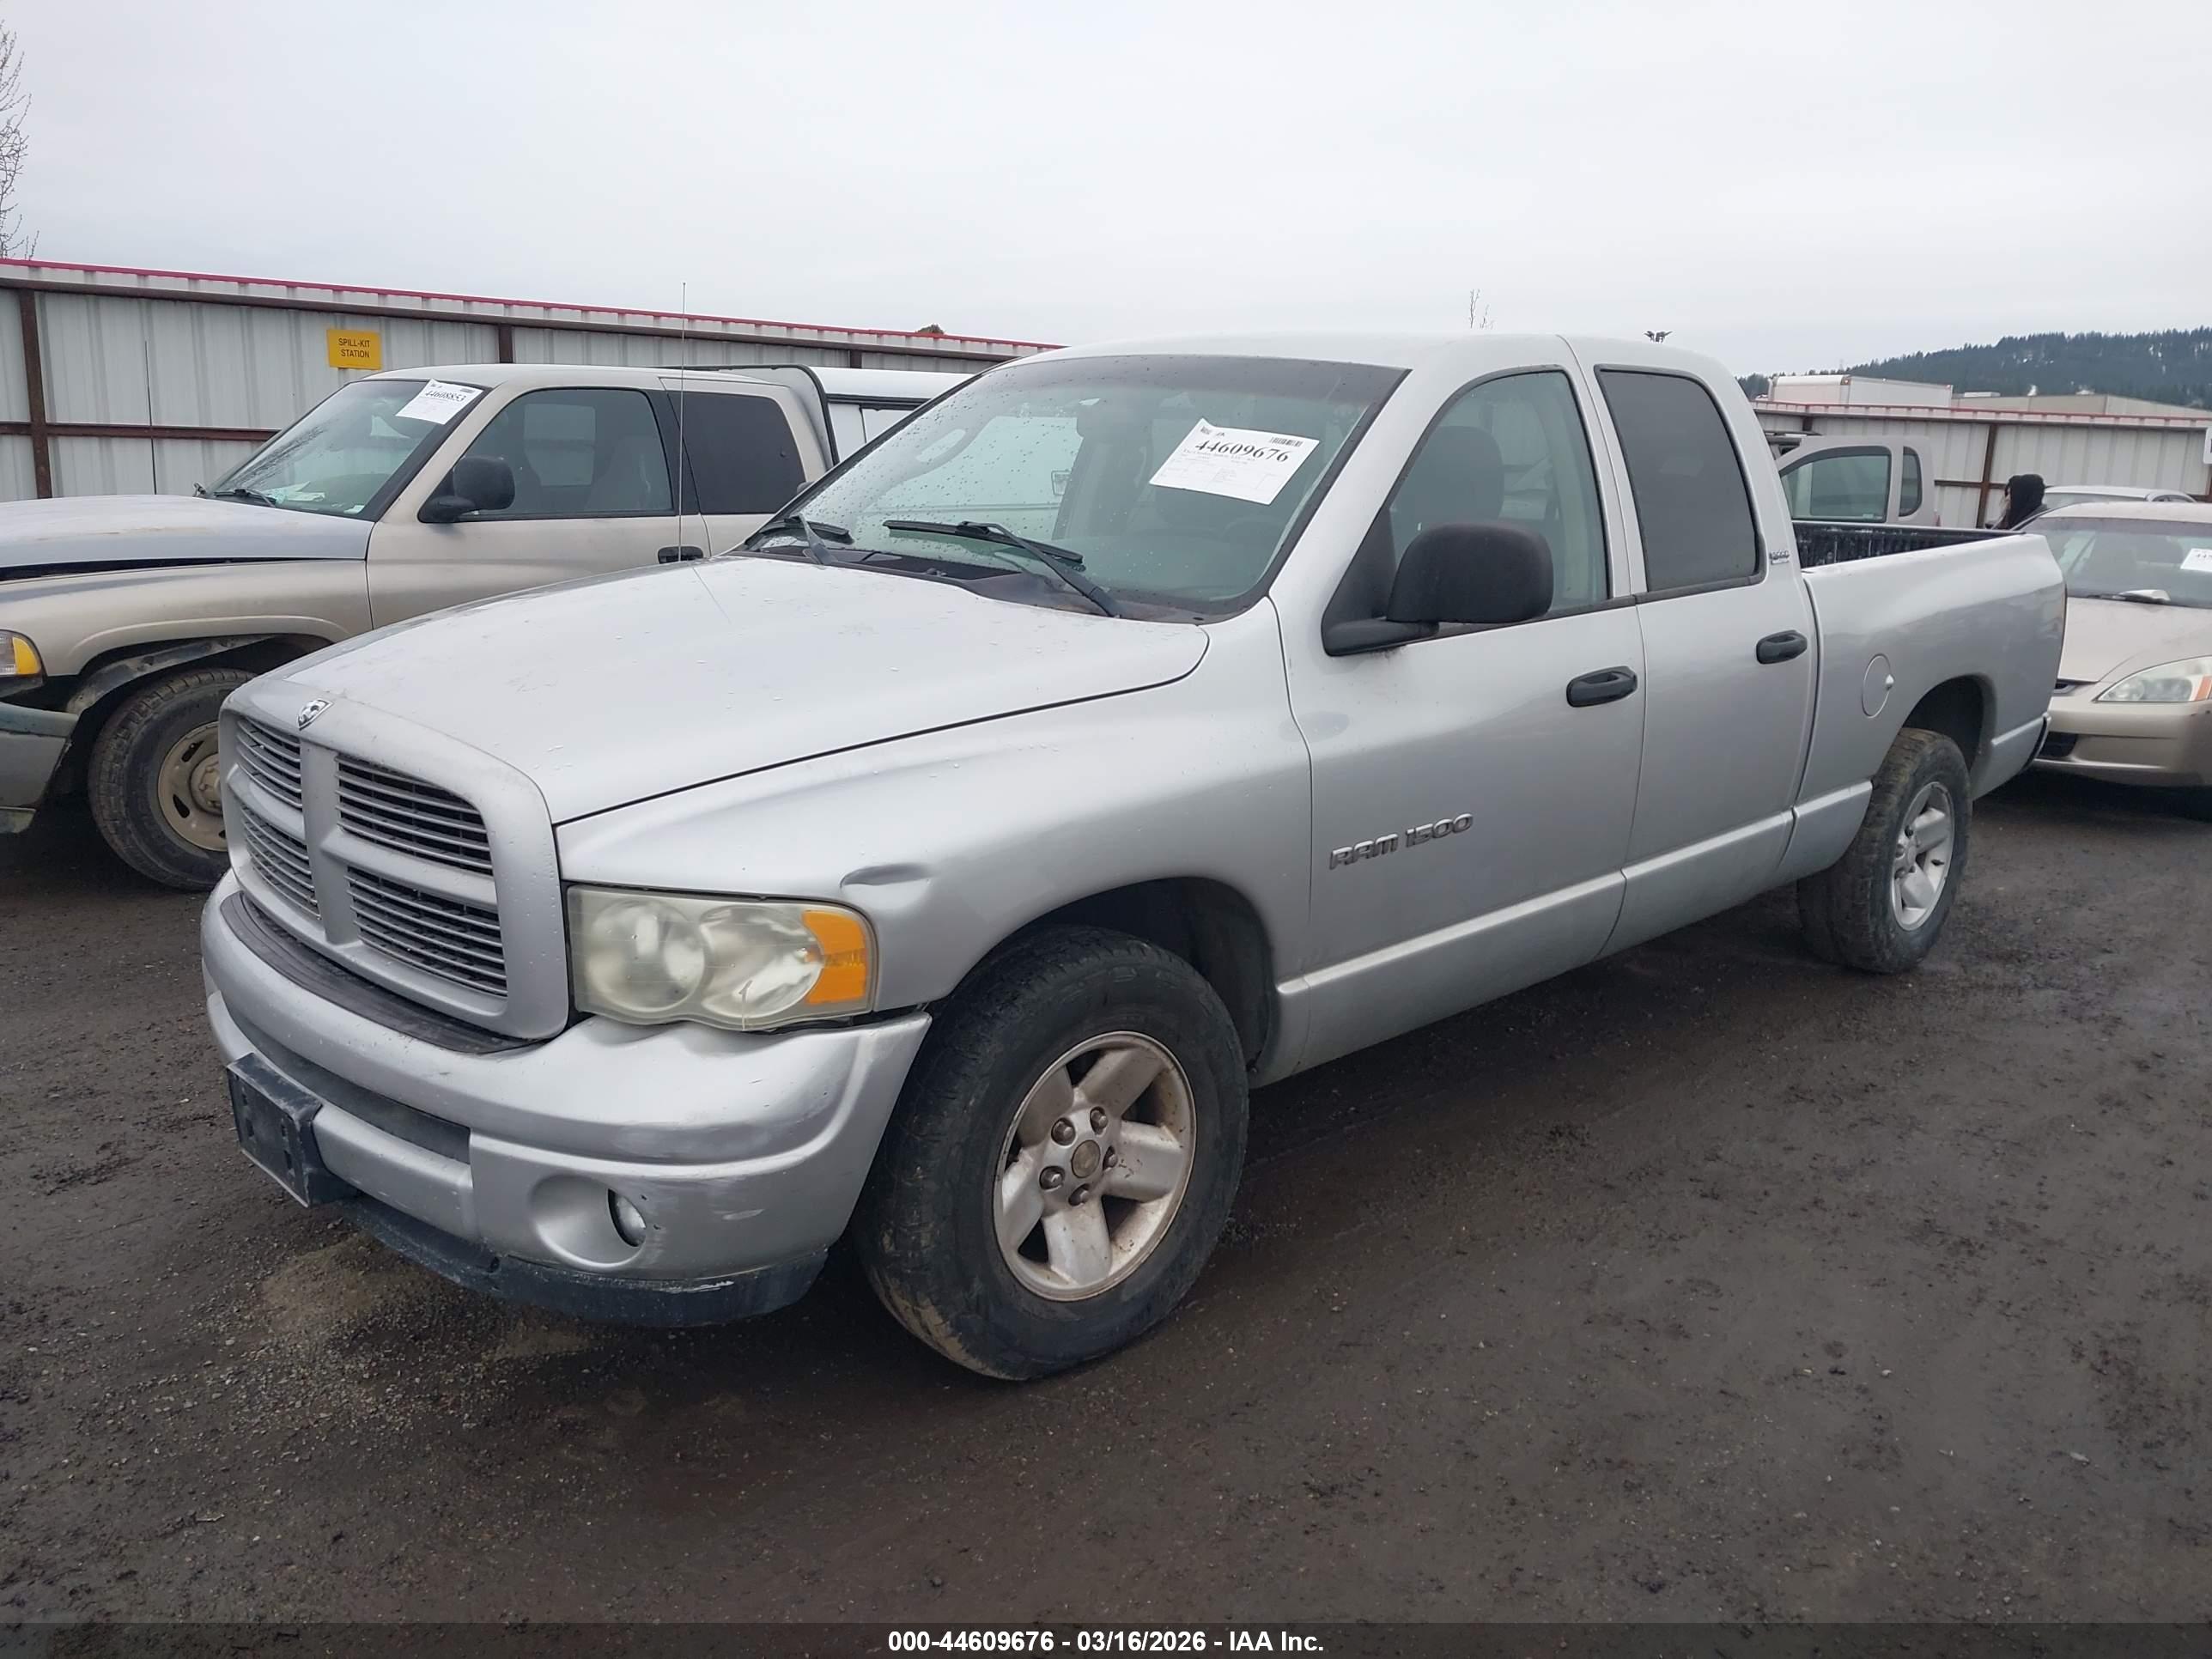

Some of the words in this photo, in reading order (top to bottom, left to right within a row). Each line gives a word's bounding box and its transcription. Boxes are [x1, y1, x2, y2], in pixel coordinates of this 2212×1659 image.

[338, 337, 370, 348] SPILL-KIT
[340, 349, 370, 358] STATION
[1194, 440, 1291, 463] 44609676
[1329, 833, 1399, 870] RAM
[1406, 813, 1474, 848] 1500
